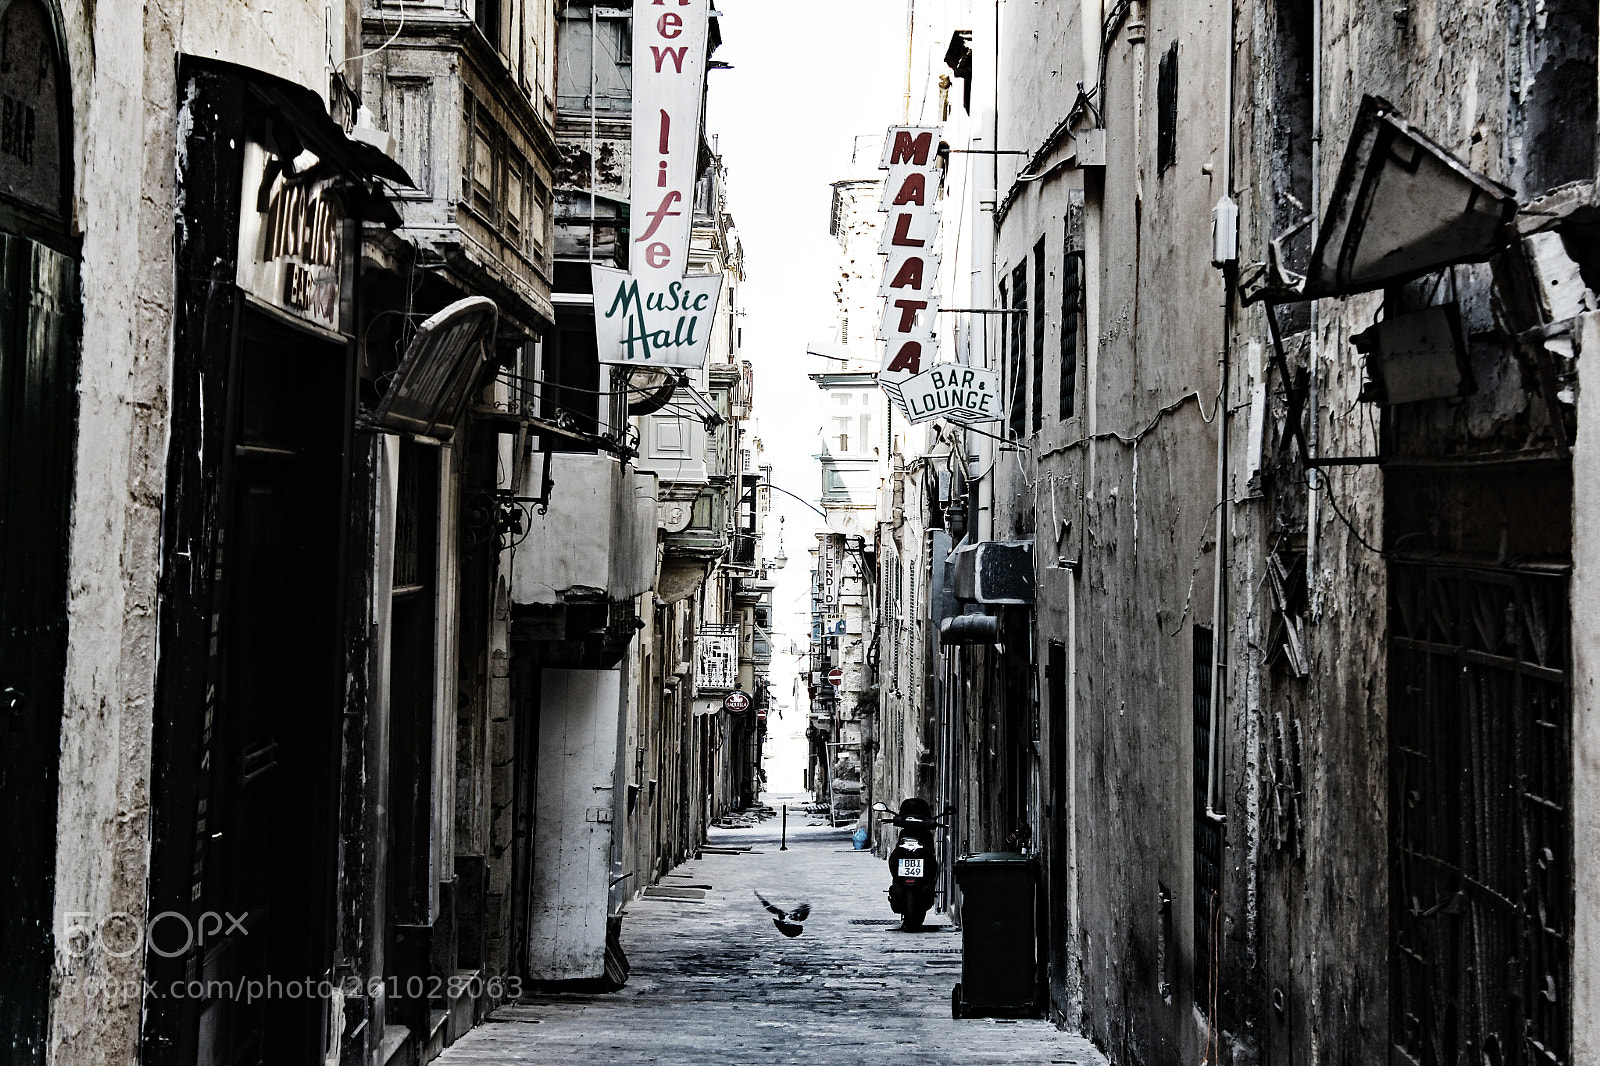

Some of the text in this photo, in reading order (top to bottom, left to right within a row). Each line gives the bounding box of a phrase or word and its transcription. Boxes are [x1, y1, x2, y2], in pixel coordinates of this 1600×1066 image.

[635, 0, 688, 269] ew life
[887, 131, 932, 374] MALATA
[620, 313, 698, 359] Hall
[910, 389, 993, 415] LOUNGE
[931, 369, 974, 390] BAR
[826, 535, 834, 603] SPLENDID
[904, 859, 921, 867] BBI
